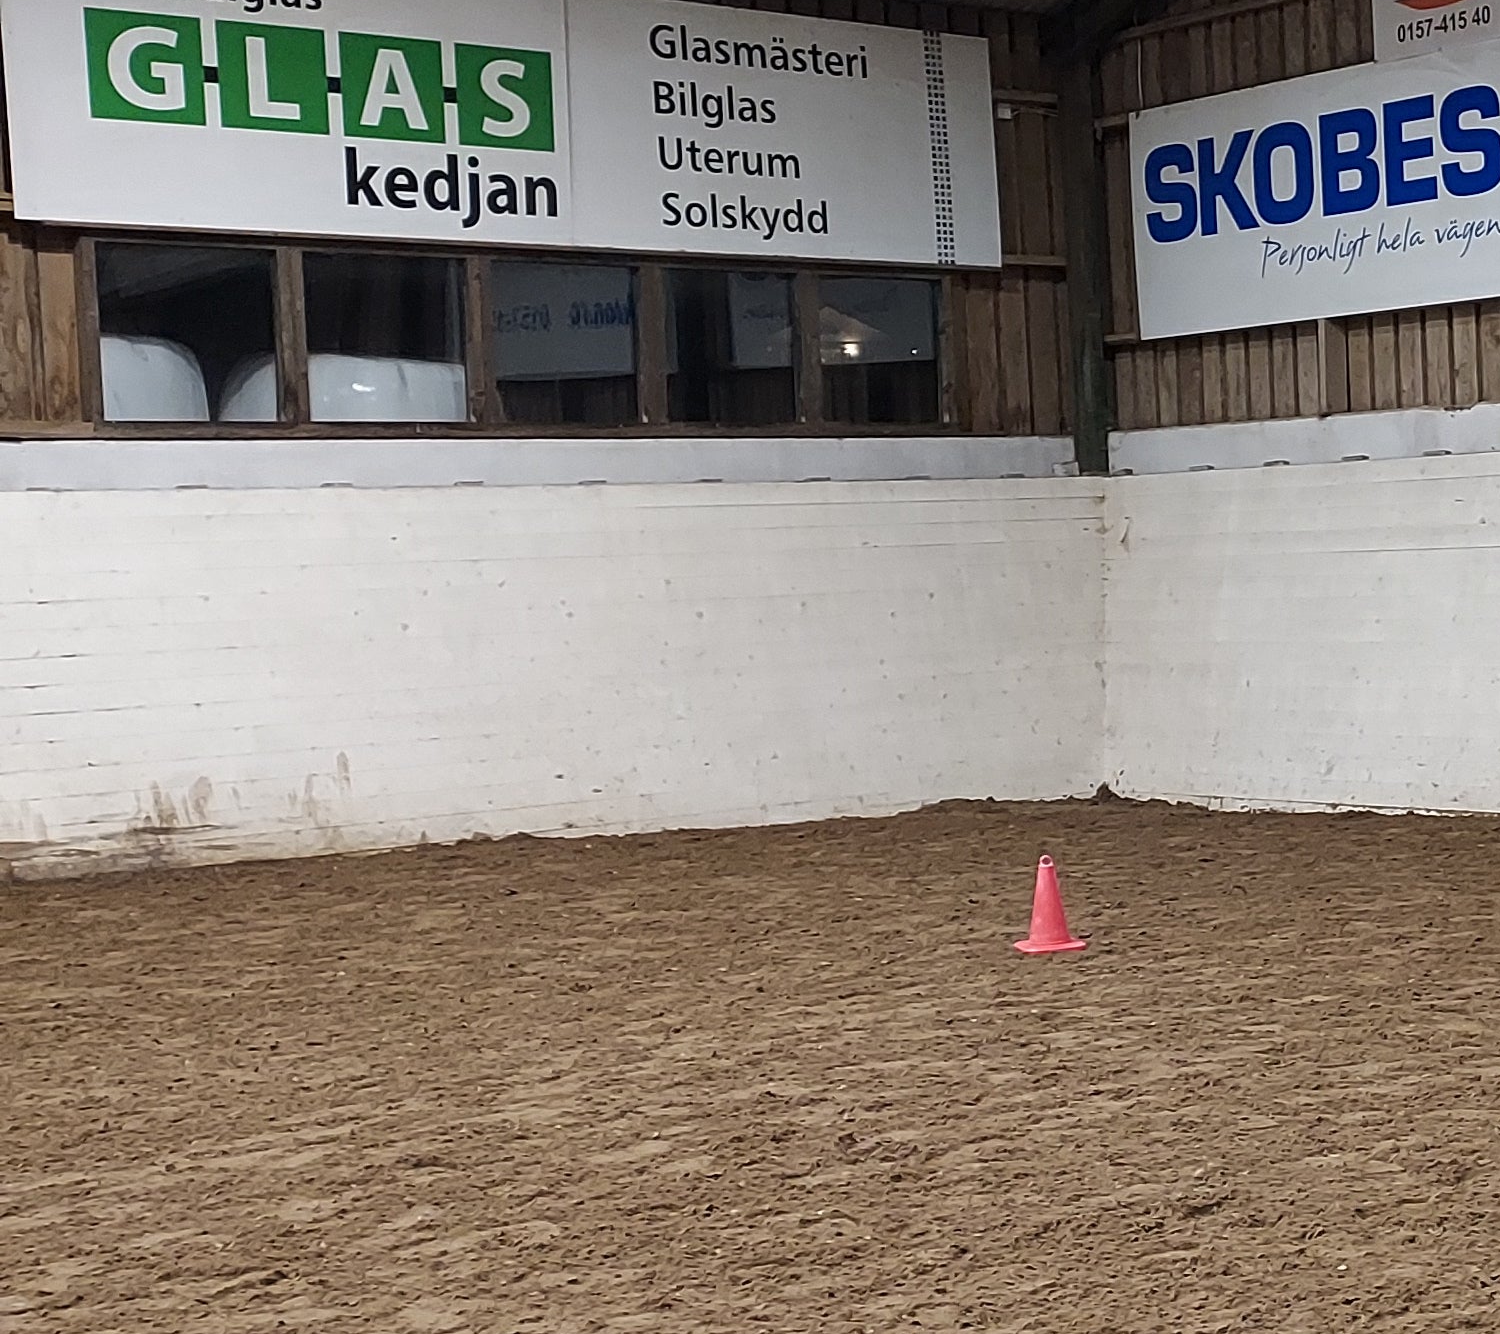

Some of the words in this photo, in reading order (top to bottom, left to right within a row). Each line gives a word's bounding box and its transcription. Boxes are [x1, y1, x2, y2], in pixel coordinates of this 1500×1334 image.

[1397, 10, 1468, 43] 0157-415
[1472, 5, 1491, 25] 40
[649, 24, 868, 79] Glasmästeri
[653, 81, 776, 128] Bilglas
[658, 136, 800, 178] Uterum
[345, 146, 558, 228] kedjan
[662, 192, 828, 240] Solskydd
[1262, 226, 1368, 277] Personligt
[1377, 217, 1424, 255] hela
